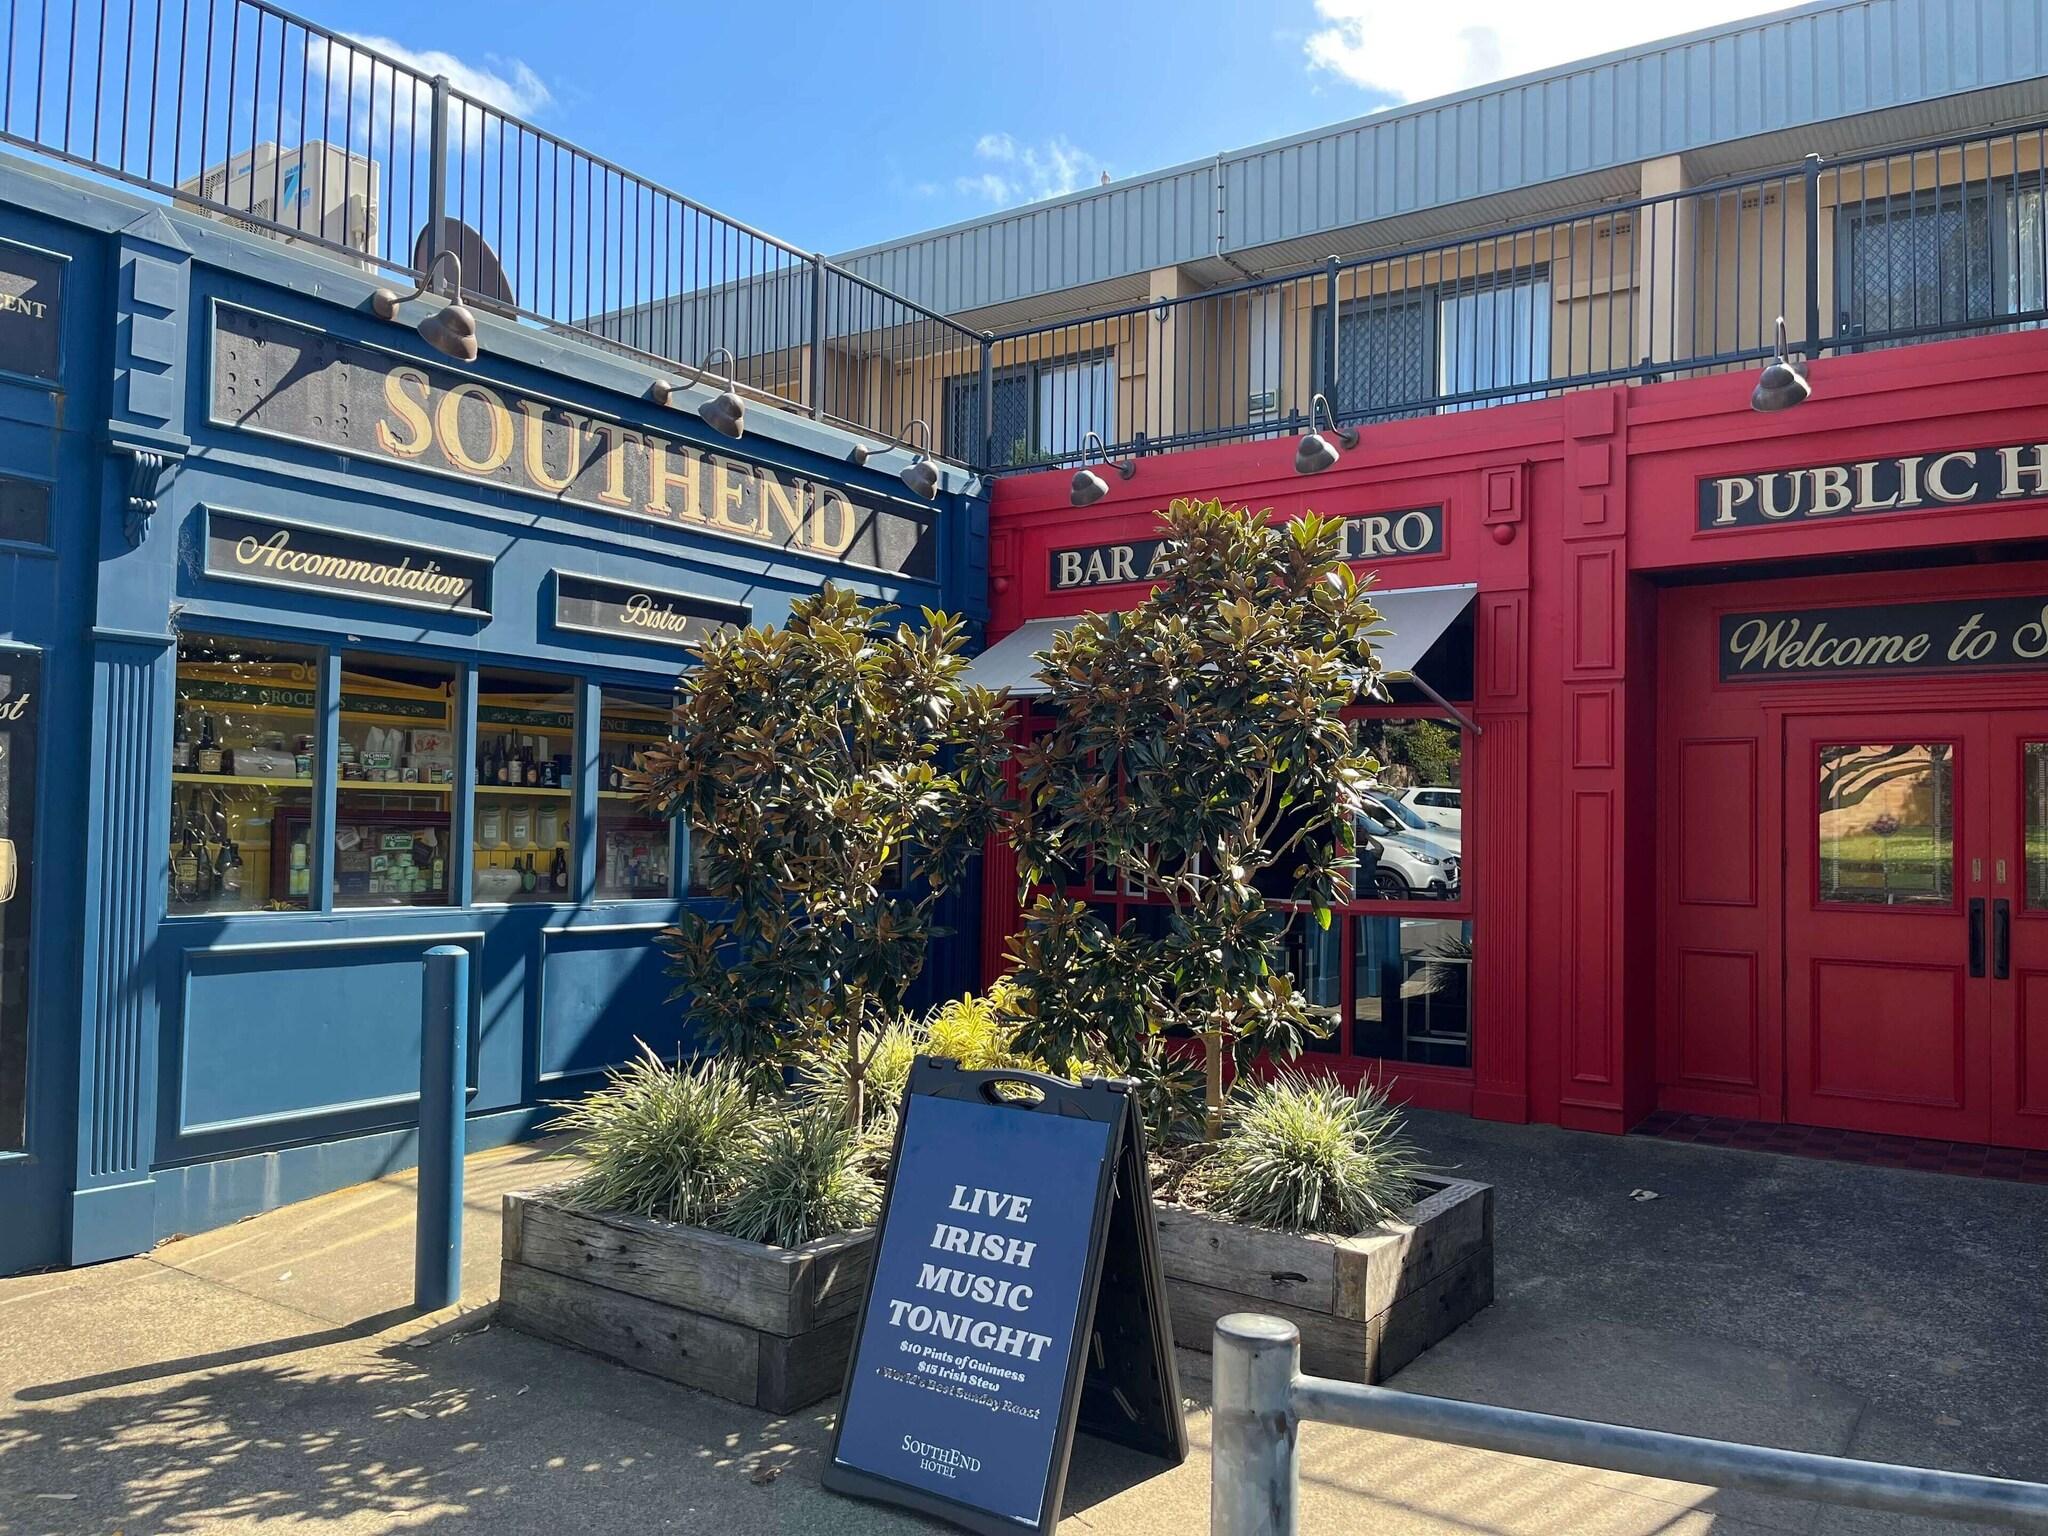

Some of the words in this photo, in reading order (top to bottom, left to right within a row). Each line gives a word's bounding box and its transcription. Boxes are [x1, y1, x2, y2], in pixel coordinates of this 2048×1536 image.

[376, 366, 857, 557] SOUTHEND
[1712, 451, 1978, 526] PUBLIC
[236, 530, 465, 597] Accommodation
[1058, 547, 1139, 588] BAR
[620, 594, 687, 633] Bistro
[1729, 617, 1931, 671] Welcome
[1947, 613, 1997, 662] to
[948, 1184, 1033, 1224] LIVE
[930, 1223, 1036, 1269] IRISH
[915, 1262, 1035, 1312] MUSIC
[889, 1298, 1052, 1363] TONIGHT
[899, 1340, 922, 1355] $10
[922, 1345, 954, 1364] Pints
[955, 1355, 969, 1370] of
[968, 1358, 1026, 1383] Guinness
[917, 1361, 938, 1375] $15
[938, 1366, 967, 1383] Irish
[968, 1374, 1001, 1392] Stew
[926, 1379, 956, 1396] Best
[955, 1387, 1001, 1411] Sunday
[1001, 1400, 1041, 1420] Roast
[919, 1458, 957, 1479] HOTEL
